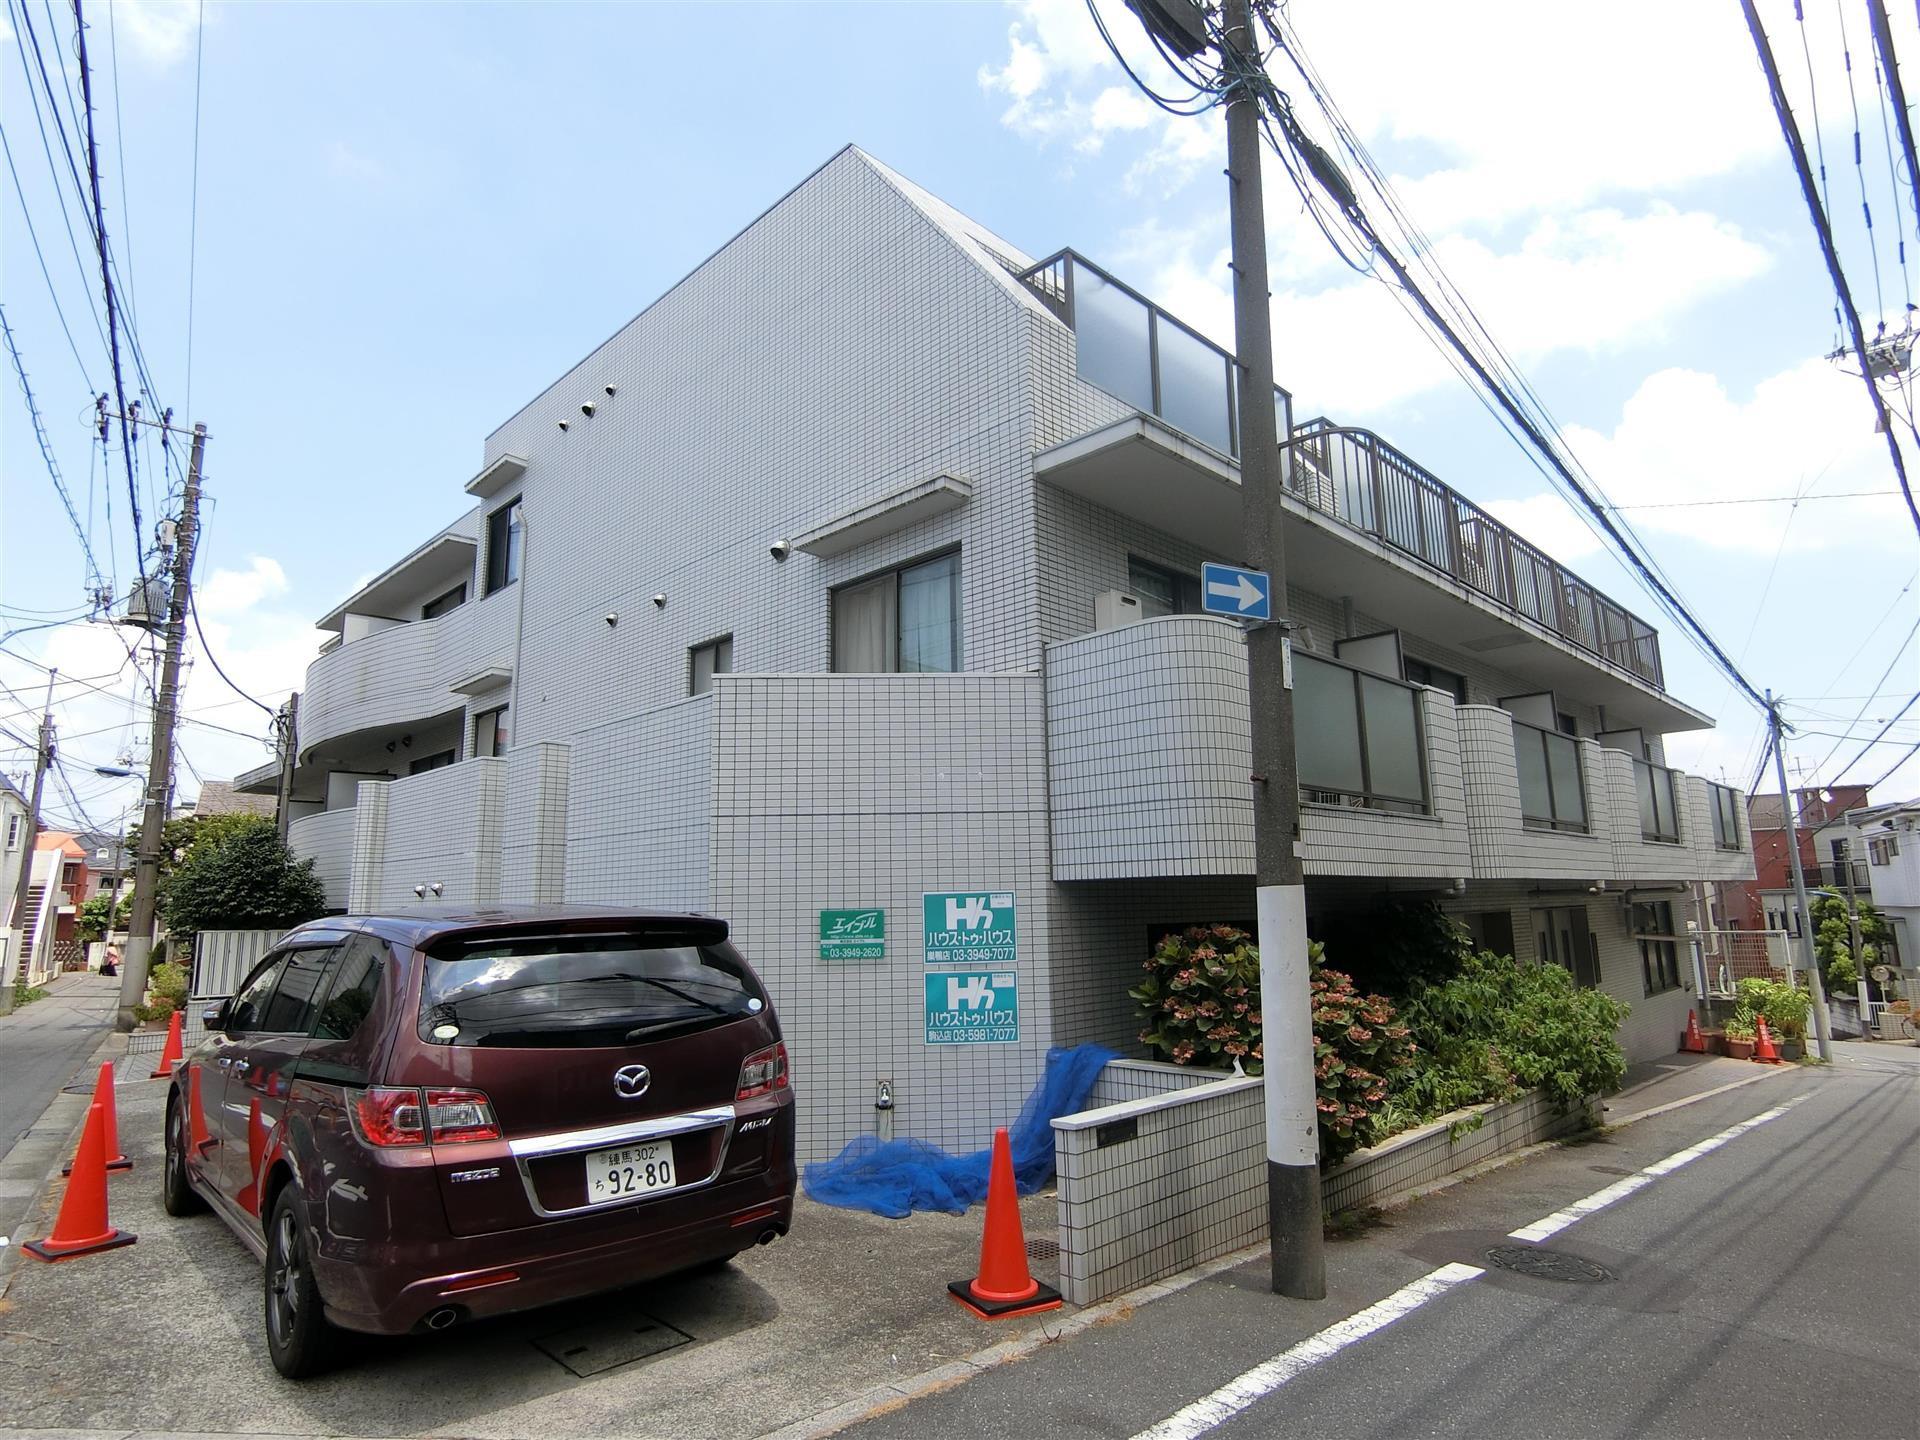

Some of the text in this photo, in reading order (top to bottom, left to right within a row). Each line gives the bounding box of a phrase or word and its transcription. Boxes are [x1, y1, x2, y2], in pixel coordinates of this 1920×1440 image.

[827, 912, 877, 934] エイブル
[928, 929, 1013, 946] ハウス・トゥ・ハウス
[830, 947, 882, 958] 03-3949-2620
[952, 947, 1015, 961] 03-3949-7077
[929, 1009, 1015, 1027] ハウス・トゥ・ハウス
[953, 1028, 1016, 1041] 03-5981-7077
[608, 1146, 656, 1166] 練馬 302
[595, 1160, 671, 1195] ち 92-80
